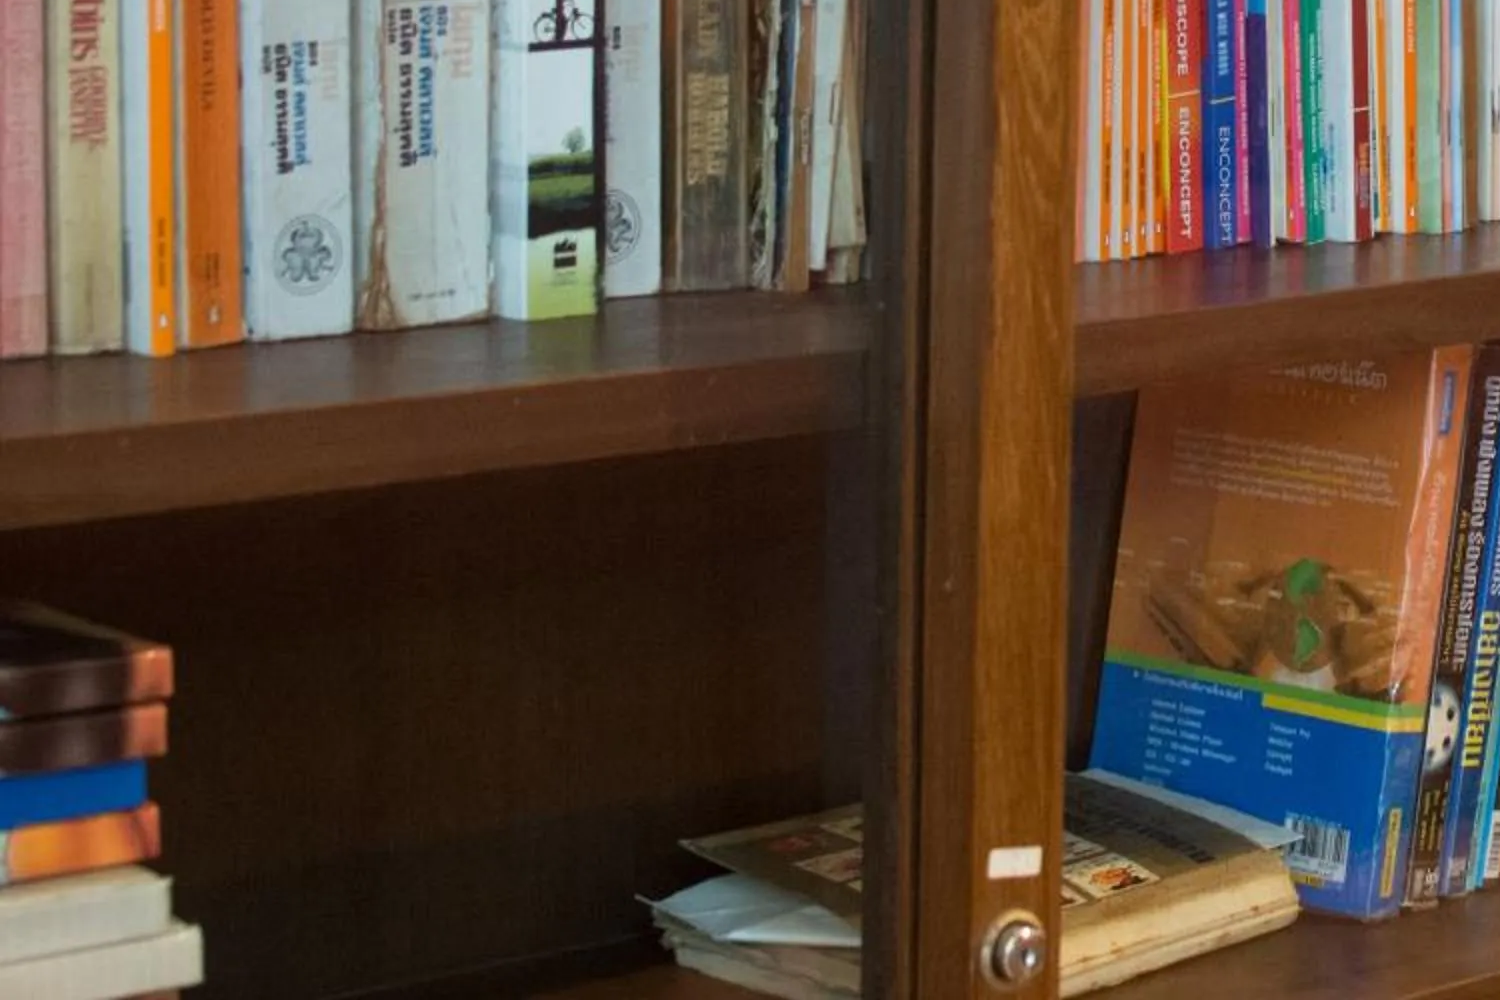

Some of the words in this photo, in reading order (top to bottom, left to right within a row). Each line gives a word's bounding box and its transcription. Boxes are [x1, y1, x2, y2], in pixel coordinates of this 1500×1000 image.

[1177, 106, 1192, 240] ENCONCEPT
[1219, 125, 1235, 243] ENCONCEPT
[1468, 438, 1497, 528] ฟังเพลง
